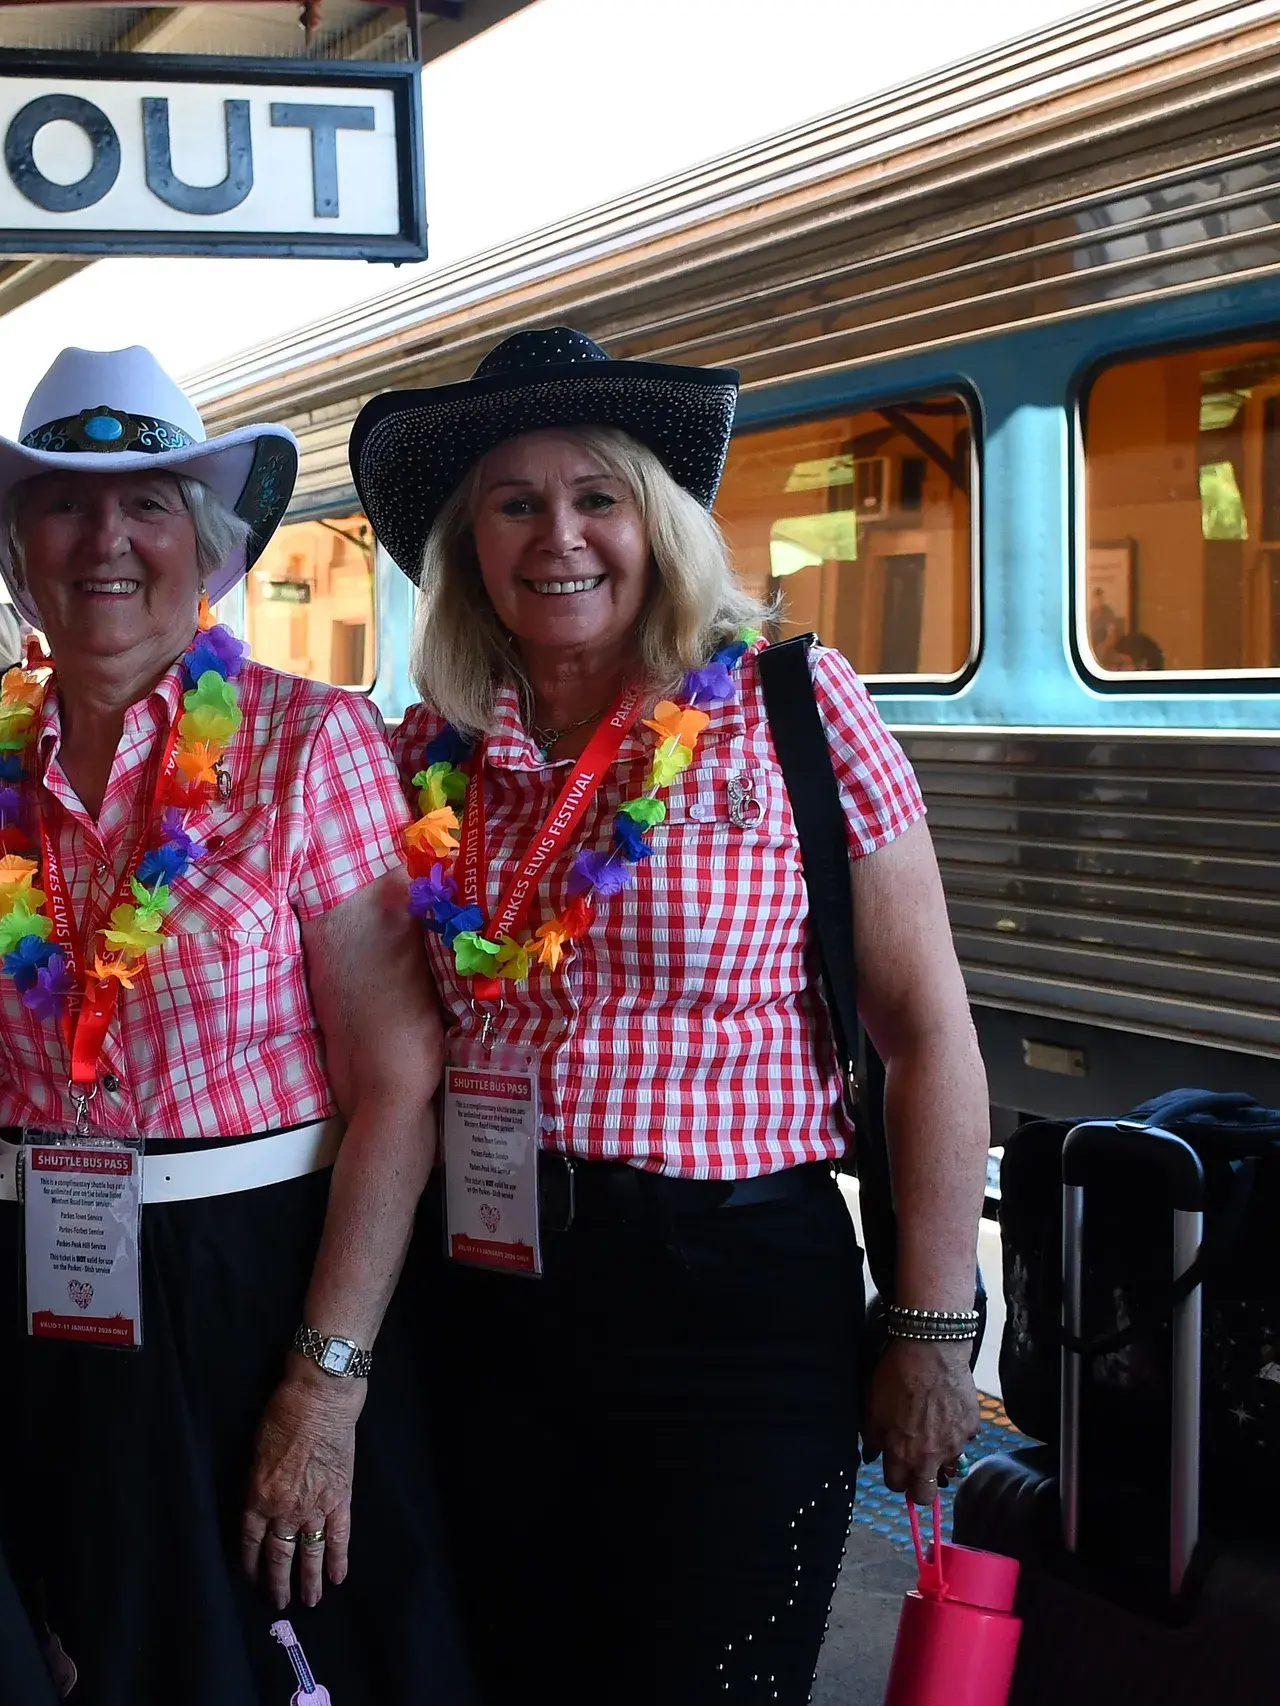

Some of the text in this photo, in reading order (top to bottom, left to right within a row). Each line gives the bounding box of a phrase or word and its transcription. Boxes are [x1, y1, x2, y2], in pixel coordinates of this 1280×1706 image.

[4, 93, 376, 219] OUT
[468, 773, 479, 827] PARKES
[465, 828, 478, 865] ELVIS
[494, 772, 595, 940] PARKES ELVIS FESTIVAL
[52, 895, 70, 937] ELVIS
[454, 1078, 528, 1095] SHUTTLE BUS PASS
[38, 1155, 128, 1170] SHUTTLE BUS PASS
[60, 1212, 74, 1220] Parkes
[88, 1228, 104, 1236] Service
[91, 1242, 106, 1250] Service
[87, 1256, 97, 1264] valid
[40, 1321, 57, 1329] VALID
[70, 1324, 97, 1333] JANUARY
[112, 1328, 128, 1336] ONLY
